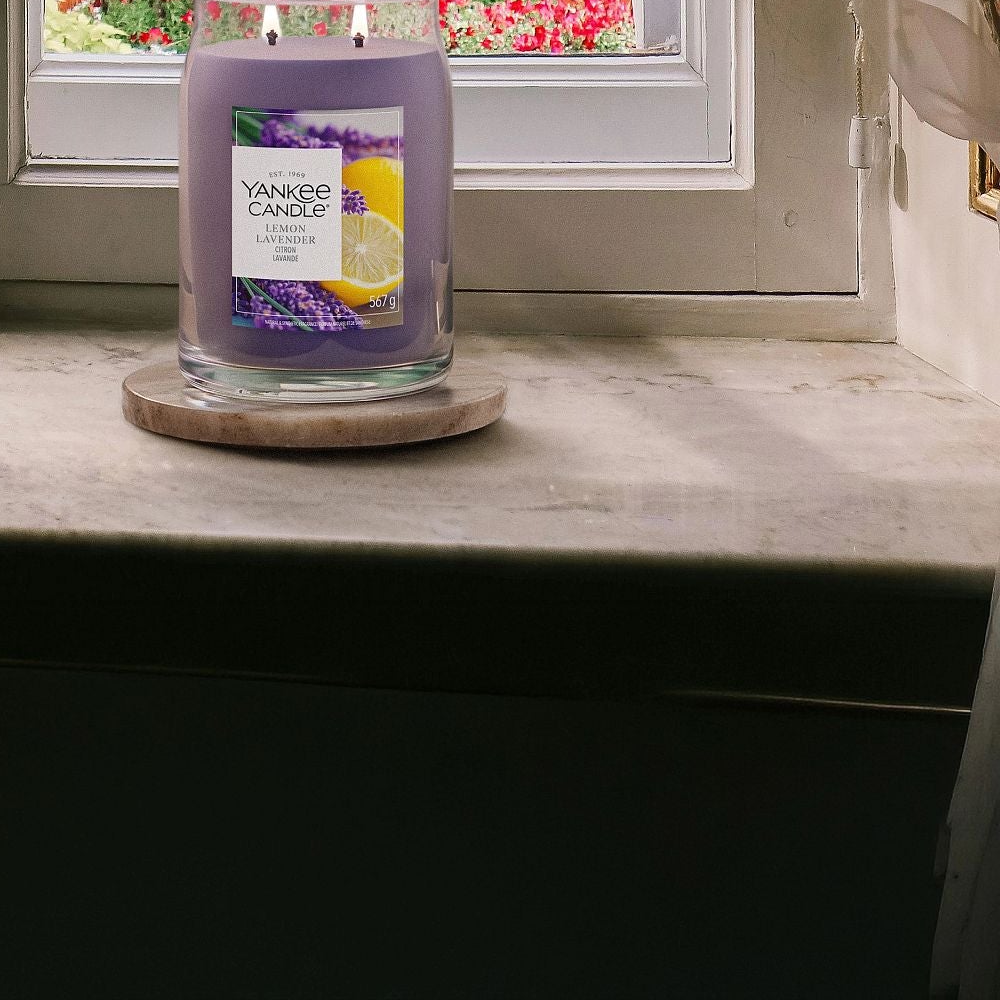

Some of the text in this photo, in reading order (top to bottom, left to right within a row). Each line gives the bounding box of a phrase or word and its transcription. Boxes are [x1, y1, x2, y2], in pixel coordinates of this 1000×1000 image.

[268, 170, 305, 178] EST. 1969
[265, 223, 306, 233] LEMON
[256, 234, 316, 245] LAVENDER
[274, 245, 297, 253] CITRON
[272, 254, 299, 262] LAVANDE
[369, 294, 396, 309] 567 g
